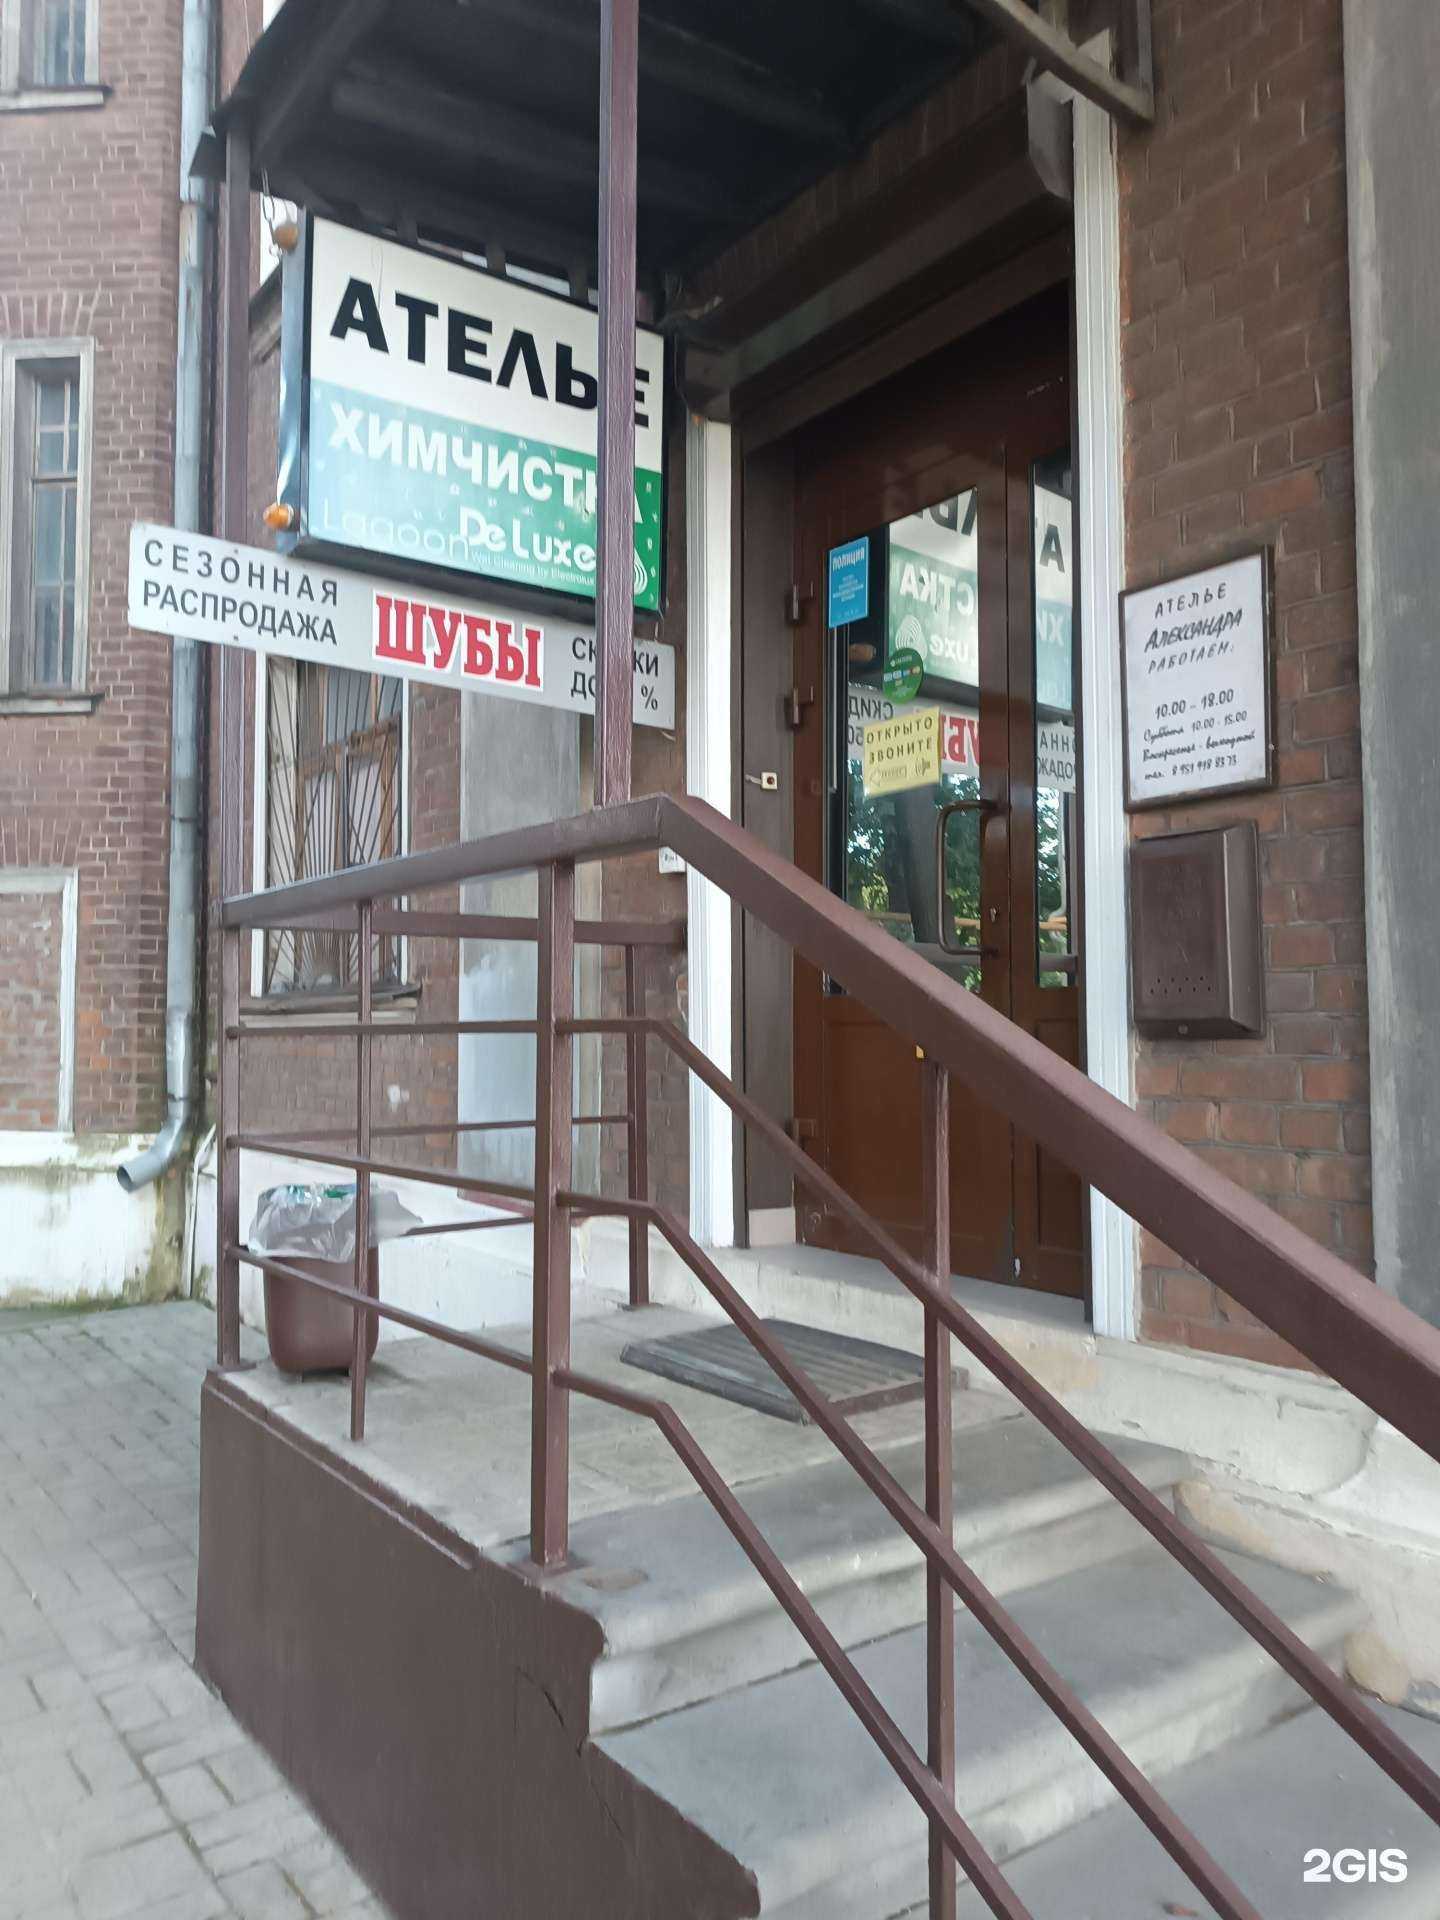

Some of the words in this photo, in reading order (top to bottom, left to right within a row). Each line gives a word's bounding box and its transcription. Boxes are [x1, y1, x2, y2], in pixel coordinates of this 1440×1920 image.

[328, 403, 643, 523] ХИМЧИСТ
[323, 497, 469, 562] Lagoon
[144, 539, 340, 607] СЕЗОННАЯ
[142, 580, 338, 647] РАСПРОДАЖА
[1155, 582, 1227, 619] АТЕЛЬЕ
[375, 594, 542, 688] ШУБЫ
[572, 637, 659, 677] СККИ
[1155, 699, 1187, 720] 10.00
[1201, 688, 1234, 710] 18.00
[866, 716, 933, 745] ОТКРЫТО
[1191, 717, 1215, 733] 10.00
[868, 737, 933, 765] ЗВОНИТЕ
